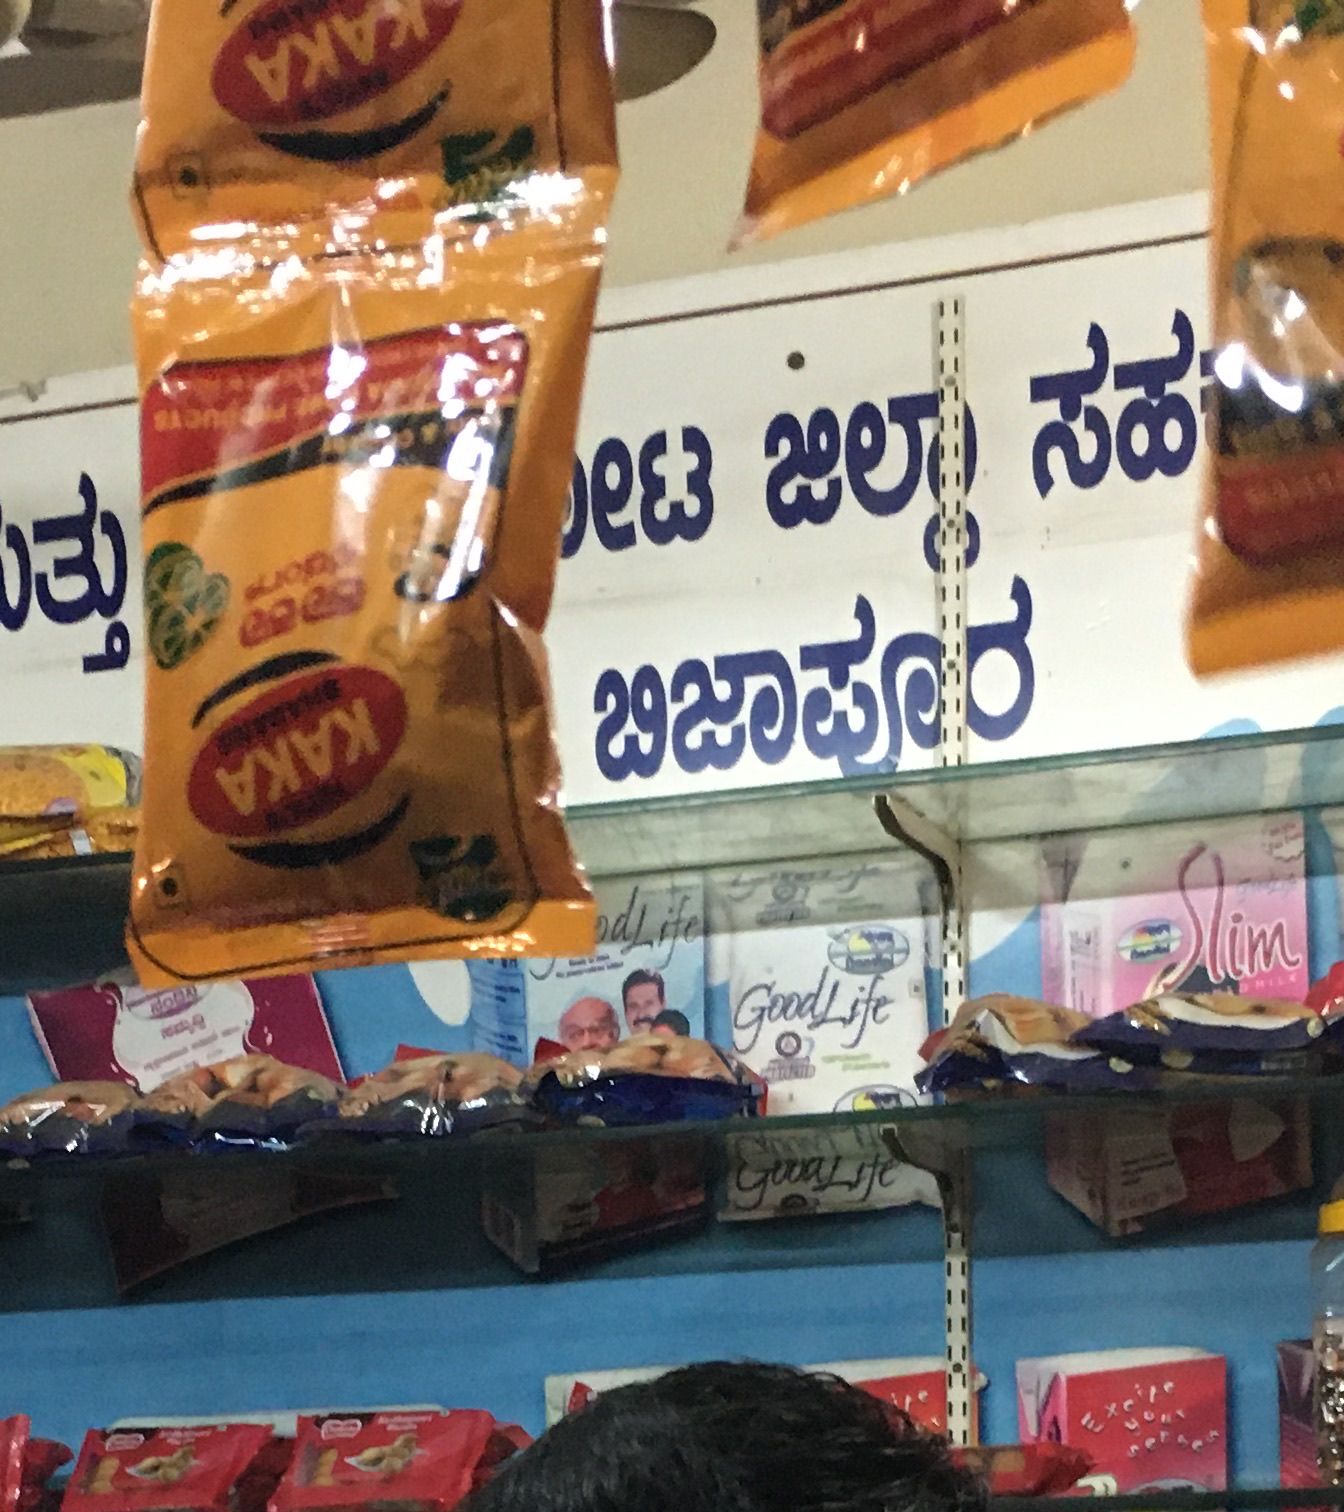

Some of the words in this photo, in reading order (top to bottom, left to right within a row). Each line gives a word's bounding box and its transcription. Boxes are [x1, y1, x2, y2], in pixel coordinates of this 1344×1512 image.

[244, 0, 431, 103] KAKA
[214, 696, 383, 817] KAKA
[1162, 841, 1301, 992] Slim
[733, 965, 896, 1055] GoodLife
